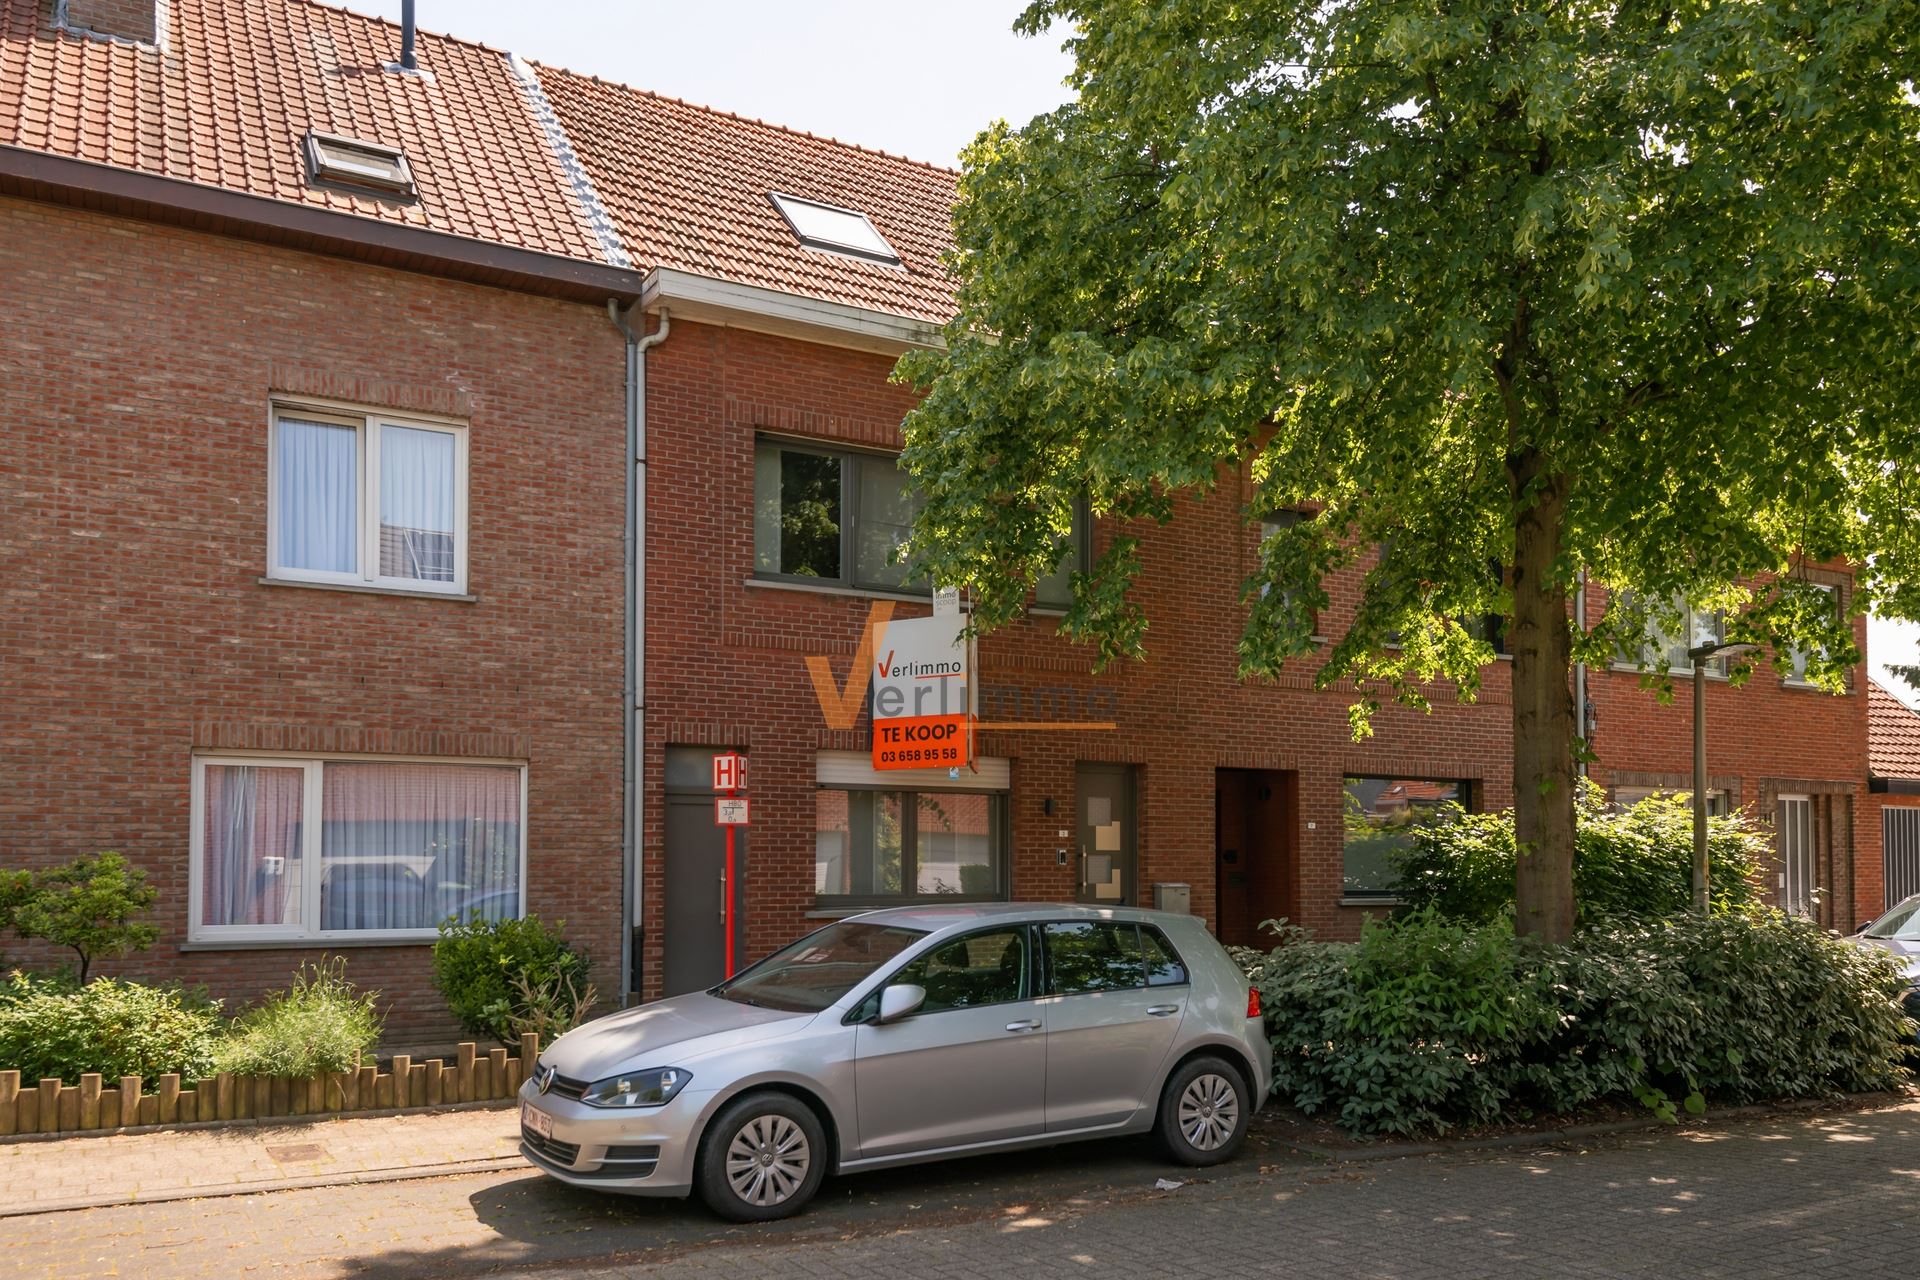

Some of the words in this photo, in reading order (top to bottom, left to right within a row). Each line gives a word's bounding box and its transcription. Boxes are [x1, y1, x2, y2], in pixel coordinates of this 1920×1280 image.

[878, 650, 962, 678] Verlimmo
[881, 726, 901, 743] TE
[905, 723, 958, 742] KOOP
[881, 751, 896, 762] 03
[898, 749, 922, 762] 658
[924, 748, 939, 760] 95
[942, 747, 958, 760] 58
[717, 759, 732, 786] H
[739, 759, 747, 786] H
